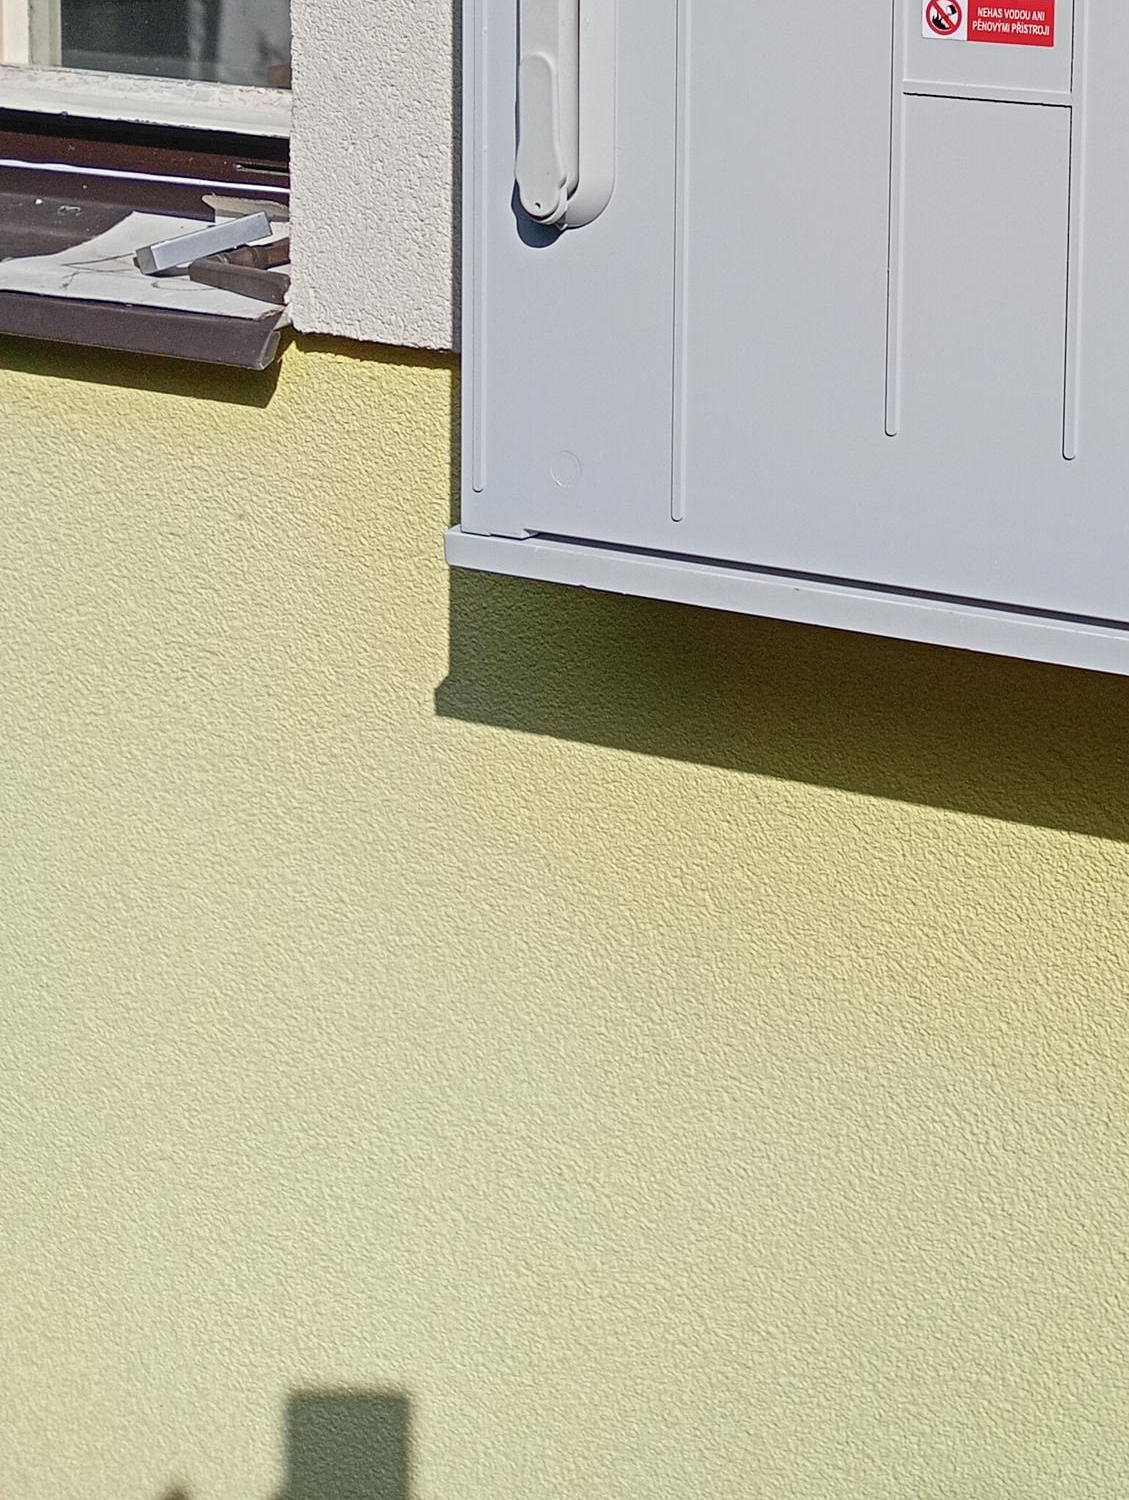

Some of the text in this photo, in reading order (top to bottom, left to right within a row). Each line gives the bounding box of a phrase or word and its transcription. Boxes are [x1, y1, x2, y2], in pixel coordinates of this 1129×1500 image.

[977, 7, 1045, 21] NEHAS VODOU ANI
[972, 18, 1010, 33] PĚNOVÝMI
